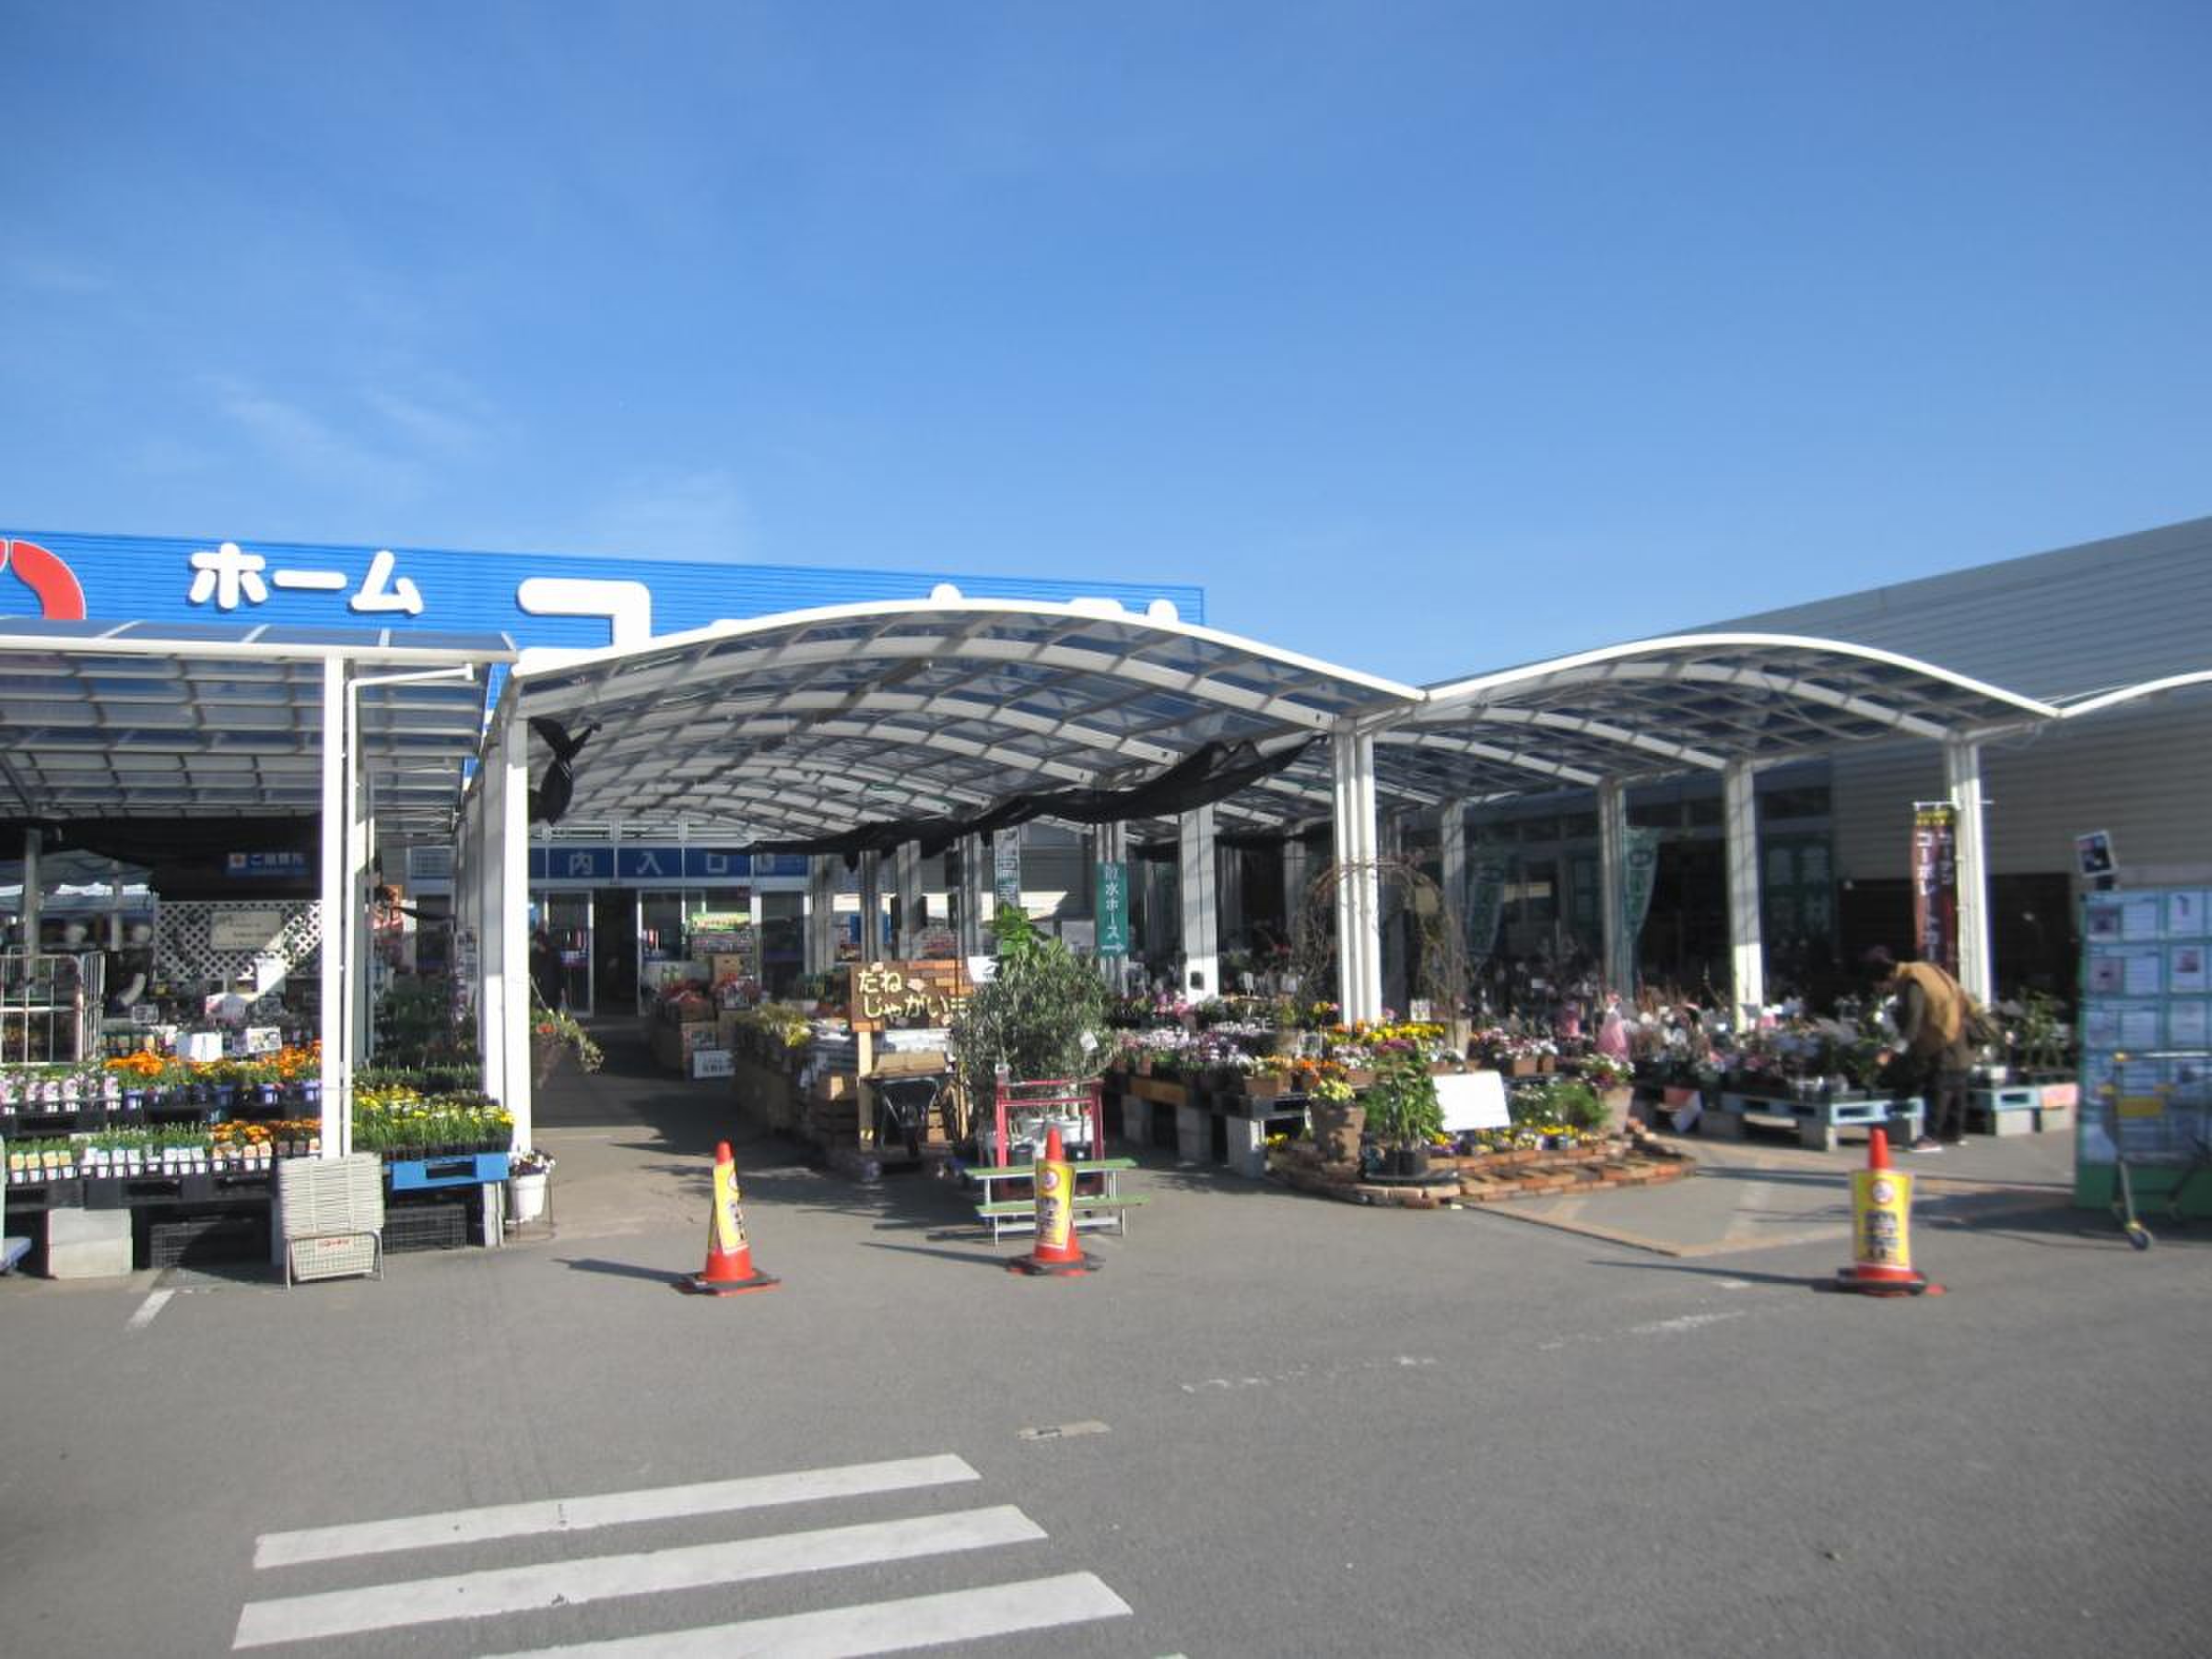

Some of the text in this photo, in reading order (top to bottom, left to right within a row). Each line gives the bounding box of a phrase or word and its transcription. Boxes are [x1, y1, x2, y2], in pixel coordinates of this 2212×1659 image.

[189, 541, 424, 615] ホーム
[858, 969, 902, 994] たね
